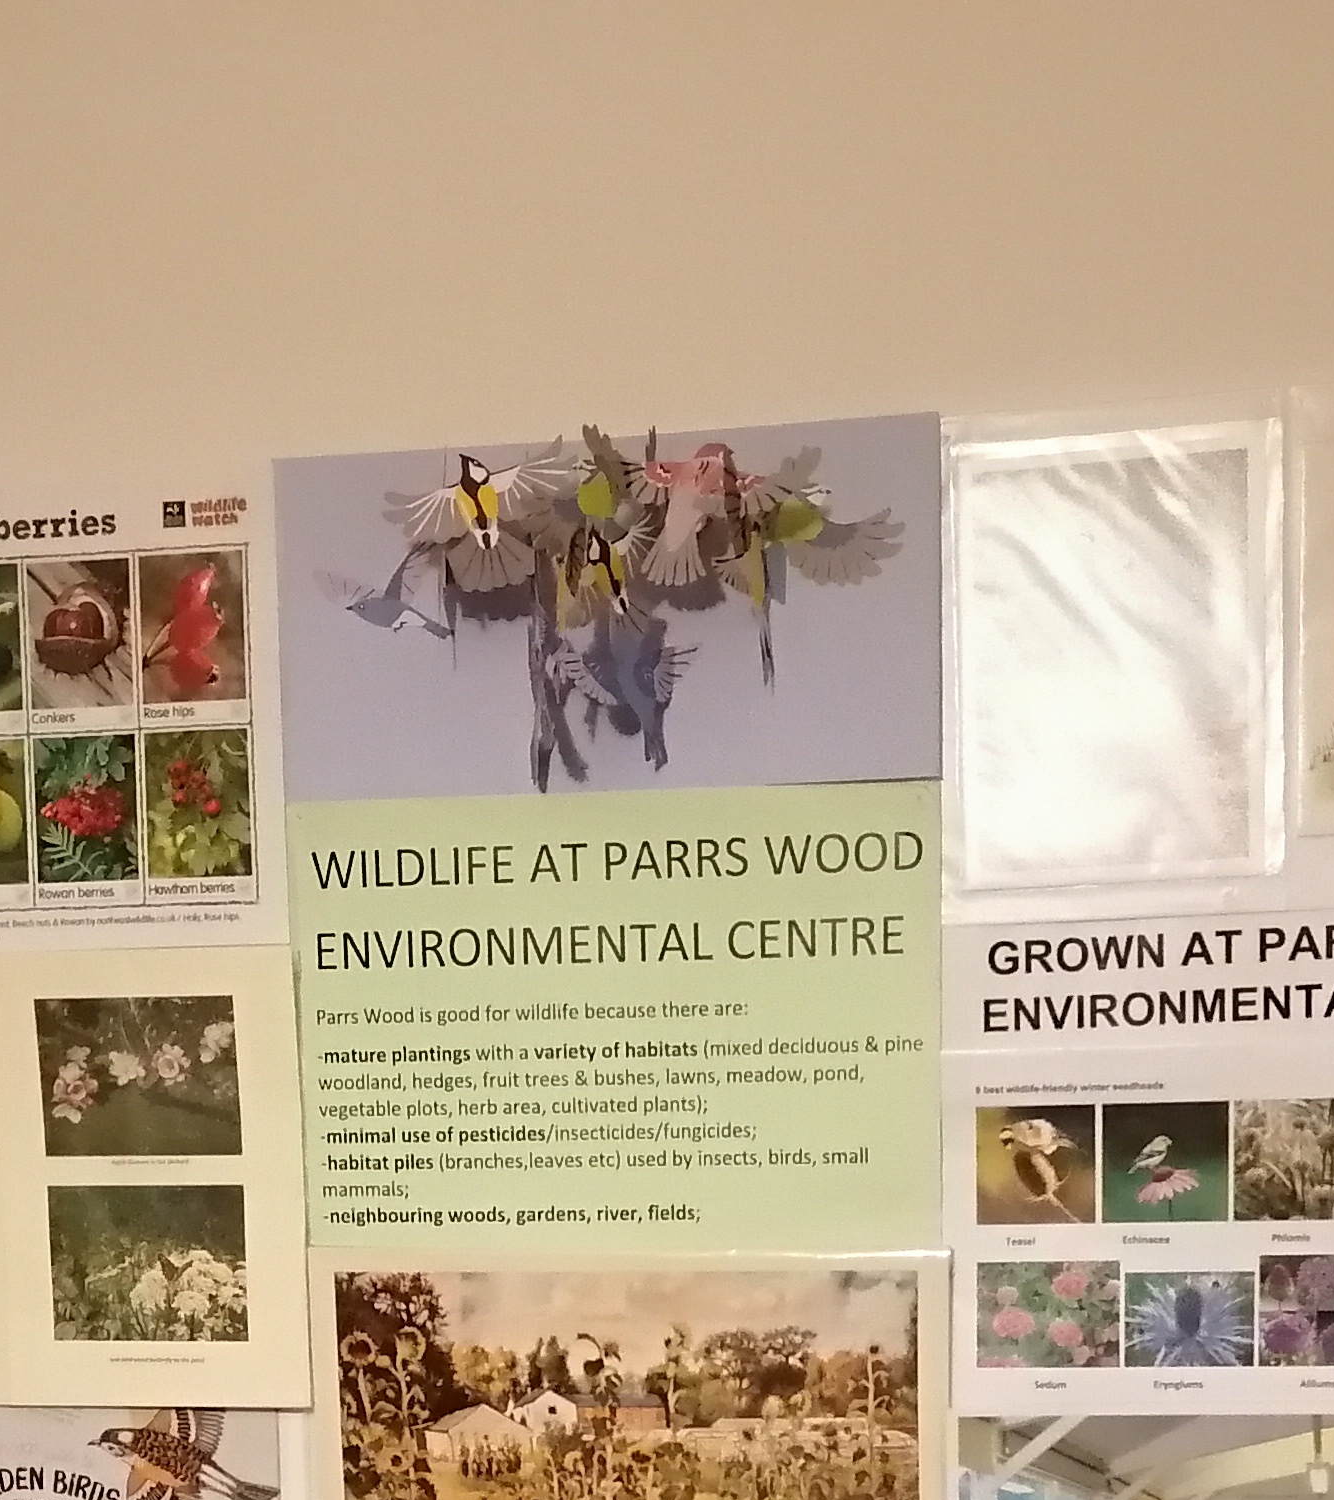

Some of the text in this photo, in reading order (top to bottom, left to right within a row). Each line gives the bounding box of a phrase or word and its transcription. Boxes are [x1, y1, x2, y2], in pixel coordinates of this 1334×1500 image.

[31, 711, 76, 725] Conkers
[143, 703, 195, 720] Rose hips
[311, 830, 923, 891] WILDLIFE AT PARRS WOOD
[38, 886, 115, 901] Rowan berries
[316, 915, 904, 971] ENVIRONMENTAL CENTRE
[987, 932, 1165, 977] GROWN
[1181, 928, 1243, 967] AT
[316, 1000, 748, 1028] Parrs Wood is good for wildlife because there are:
[321, 1122, 756, 1147] -minimal use of pesticides/insecticides/fungicides;
[324, 1203, 700, 1228] -neighbouring woods, gardens, river, fields;
